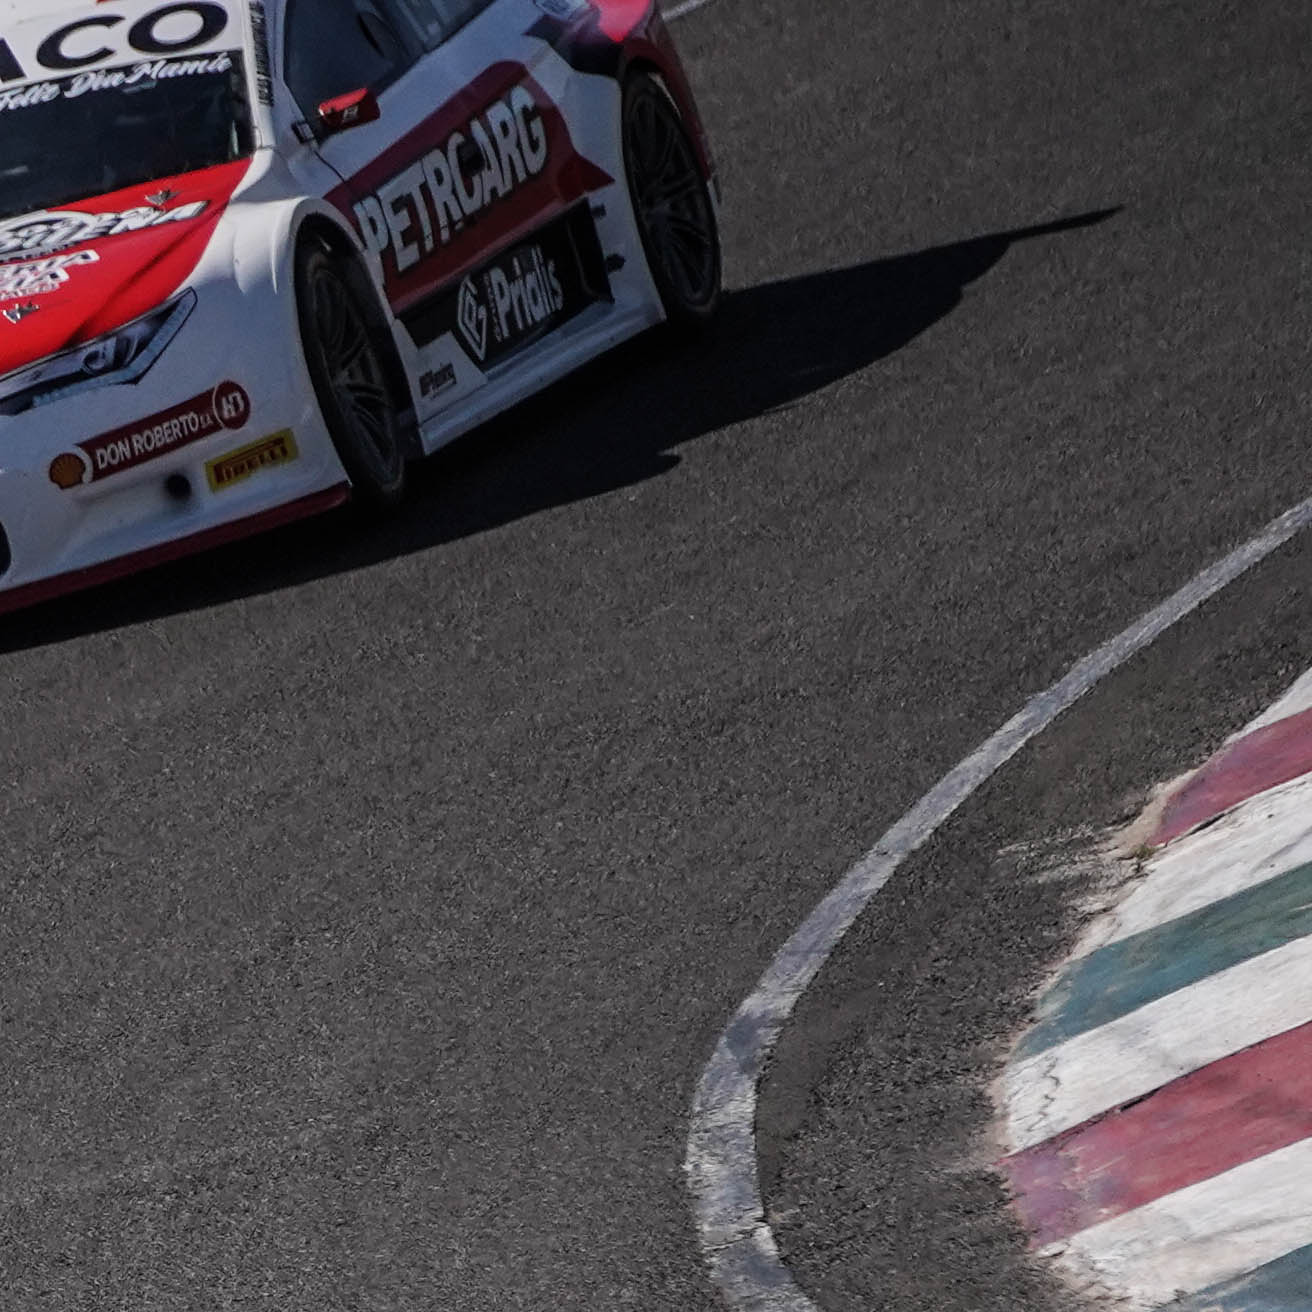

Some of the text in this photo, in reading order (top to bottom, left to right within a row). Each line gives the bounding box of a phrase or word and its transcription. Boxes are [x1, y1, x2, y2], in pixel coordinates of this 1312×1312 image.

[96, 440, 131, 470] DON
[132, 411, 200, 457] ROBERTO
[214, 437, 291, 485] PIRELLI
